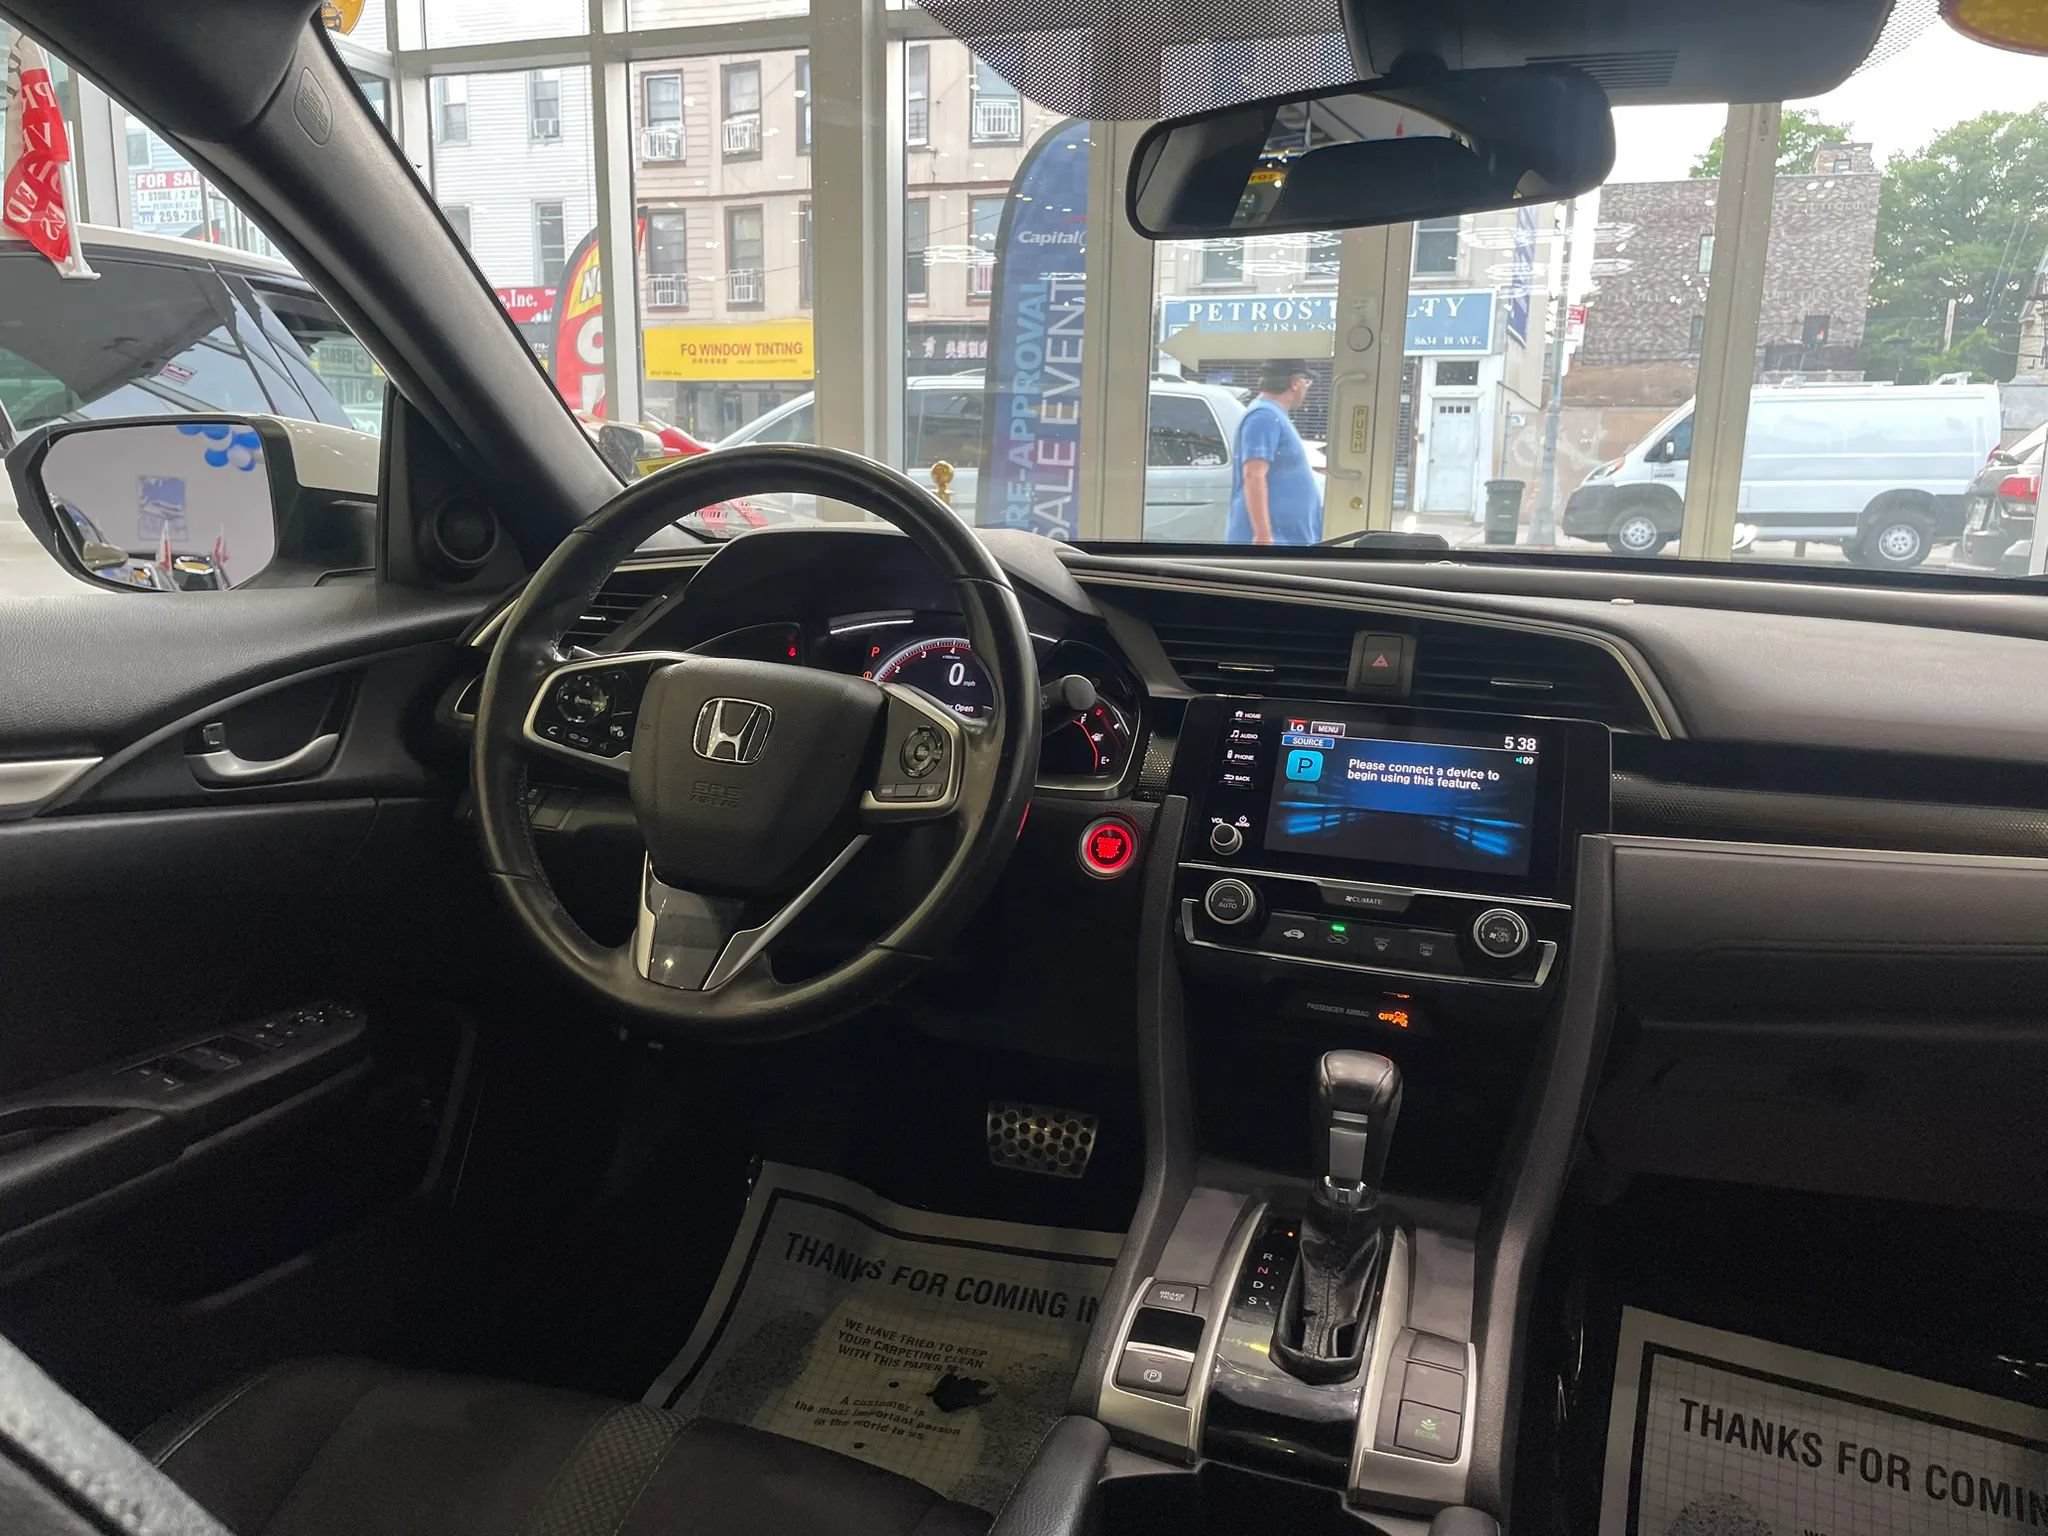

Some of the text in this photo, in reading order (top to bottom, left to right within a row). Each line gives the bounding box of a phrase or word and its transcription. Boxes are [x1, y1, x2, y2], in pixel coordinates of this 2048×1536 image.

[137, 173, 167, 188] FOR
[1018, 231, 1079, 246] Capital
[680, 342, 803, 356] FQ WINDOW TINTING
[1040, 279, 1086, 425] EVENT
[1353, 408, 1365, 450] PUSH
[955, 703, 974, 712] Open
[1290, 722, 1304, 732] Lo
[1318, 725, 1339, 733] MENU
[1292, 738, 1324, 747] SOURCE
[1349, 759, 1500, 781] Please connect a device to
[1347, 769, 1482, 790] begin using this feature.
[1351, 896, 1383, 905] CLIMATE
[1263, 1253, 1273, 1261] R
[787, 1232, 885, 1282] THANKS
[891, 1266, 948, 1297] FOR
[955, 1277, 1067, 1319] COMING
[1257, 1266, 1269, 1274] N
[1252, 1281, 1264, 1289] D
[1247, 1297, 1257, 1305] S
[845, 1318, 988, 1357] WE HAVE TRIED TO KEEP
[838, 1330, 871, 1347] YOUR
[874, 1341, 942, 1363] CARPETING
[944, 1355, 984, 1369] CLEAN
[838, 1345, 870, 1360] WITH
[874, 1354, 899, 1368] THIS
[903, 1360, 943, 1372] PAPER
[840, 1396, 849, 1405] A
[914, 1408, 927, 1417] is
[794, 1400, 961, 1435] the most important person
[891, 1426, 904, 1435] to
[1680, 1398, 1823, 1468] THANKS
[1838, 1440, 1911, 1491] FOR
